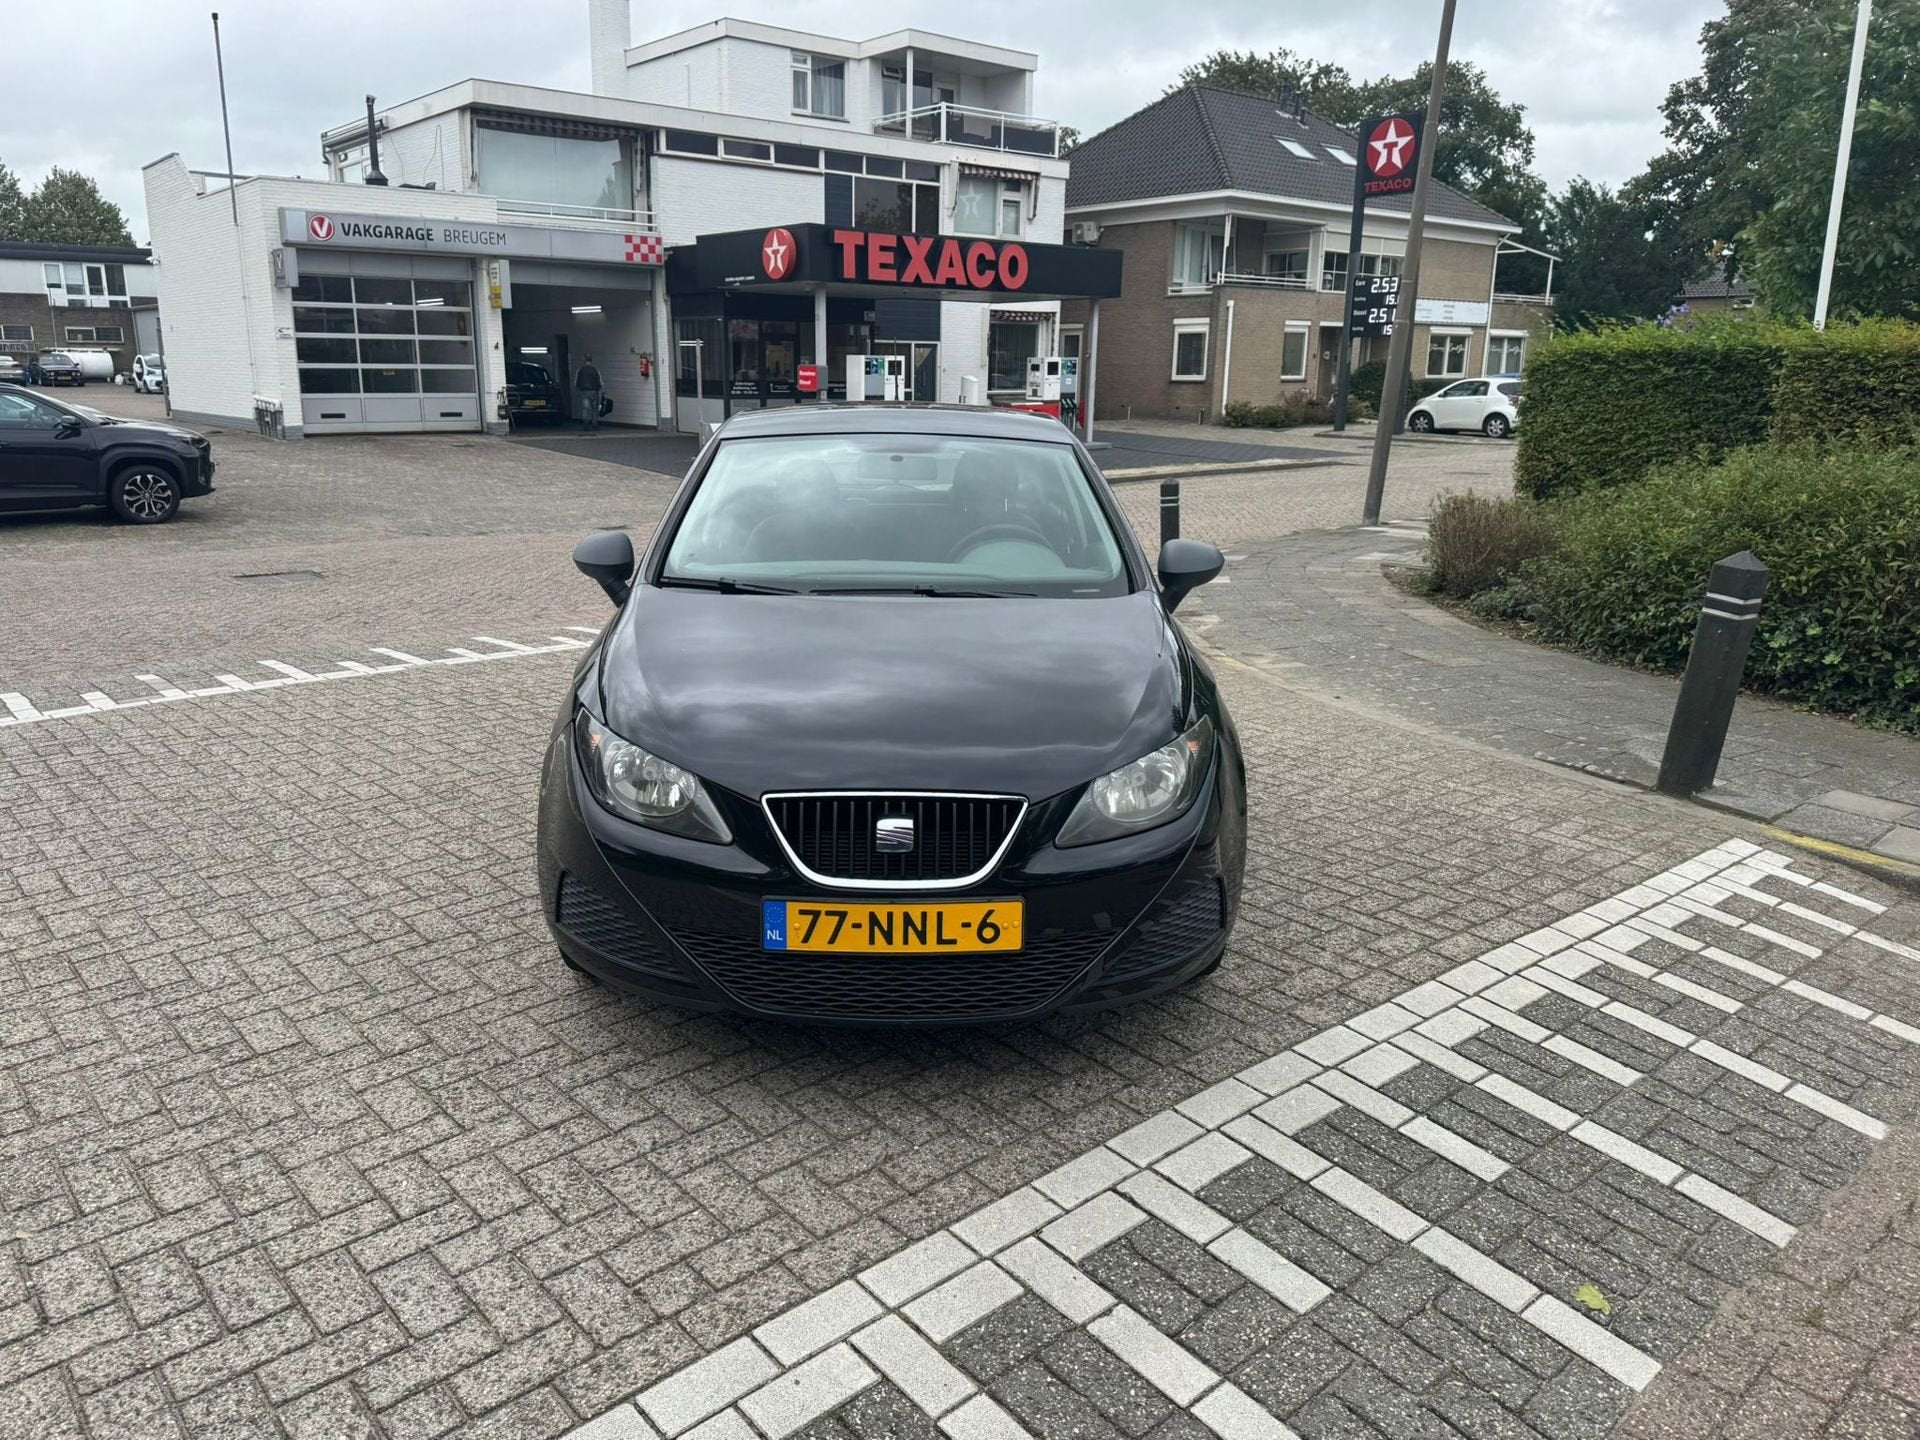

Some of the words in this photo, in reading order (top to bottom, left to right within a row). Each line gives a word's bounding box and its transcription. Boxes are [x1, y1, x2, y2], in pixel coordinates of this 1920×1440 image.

[1364, 177, 1412, 192] TEXACO
[340, 222, 434, 241] VAKGARAGE
[443, 229, 507, 246] BREUGEM
[834, 229, 1029, 290] TEXACO
[1371, 277, 1399, 293] 2.53
[766, 929, 784, 941] NL
[798, 909, 1001, 945] 77-NNL-6
